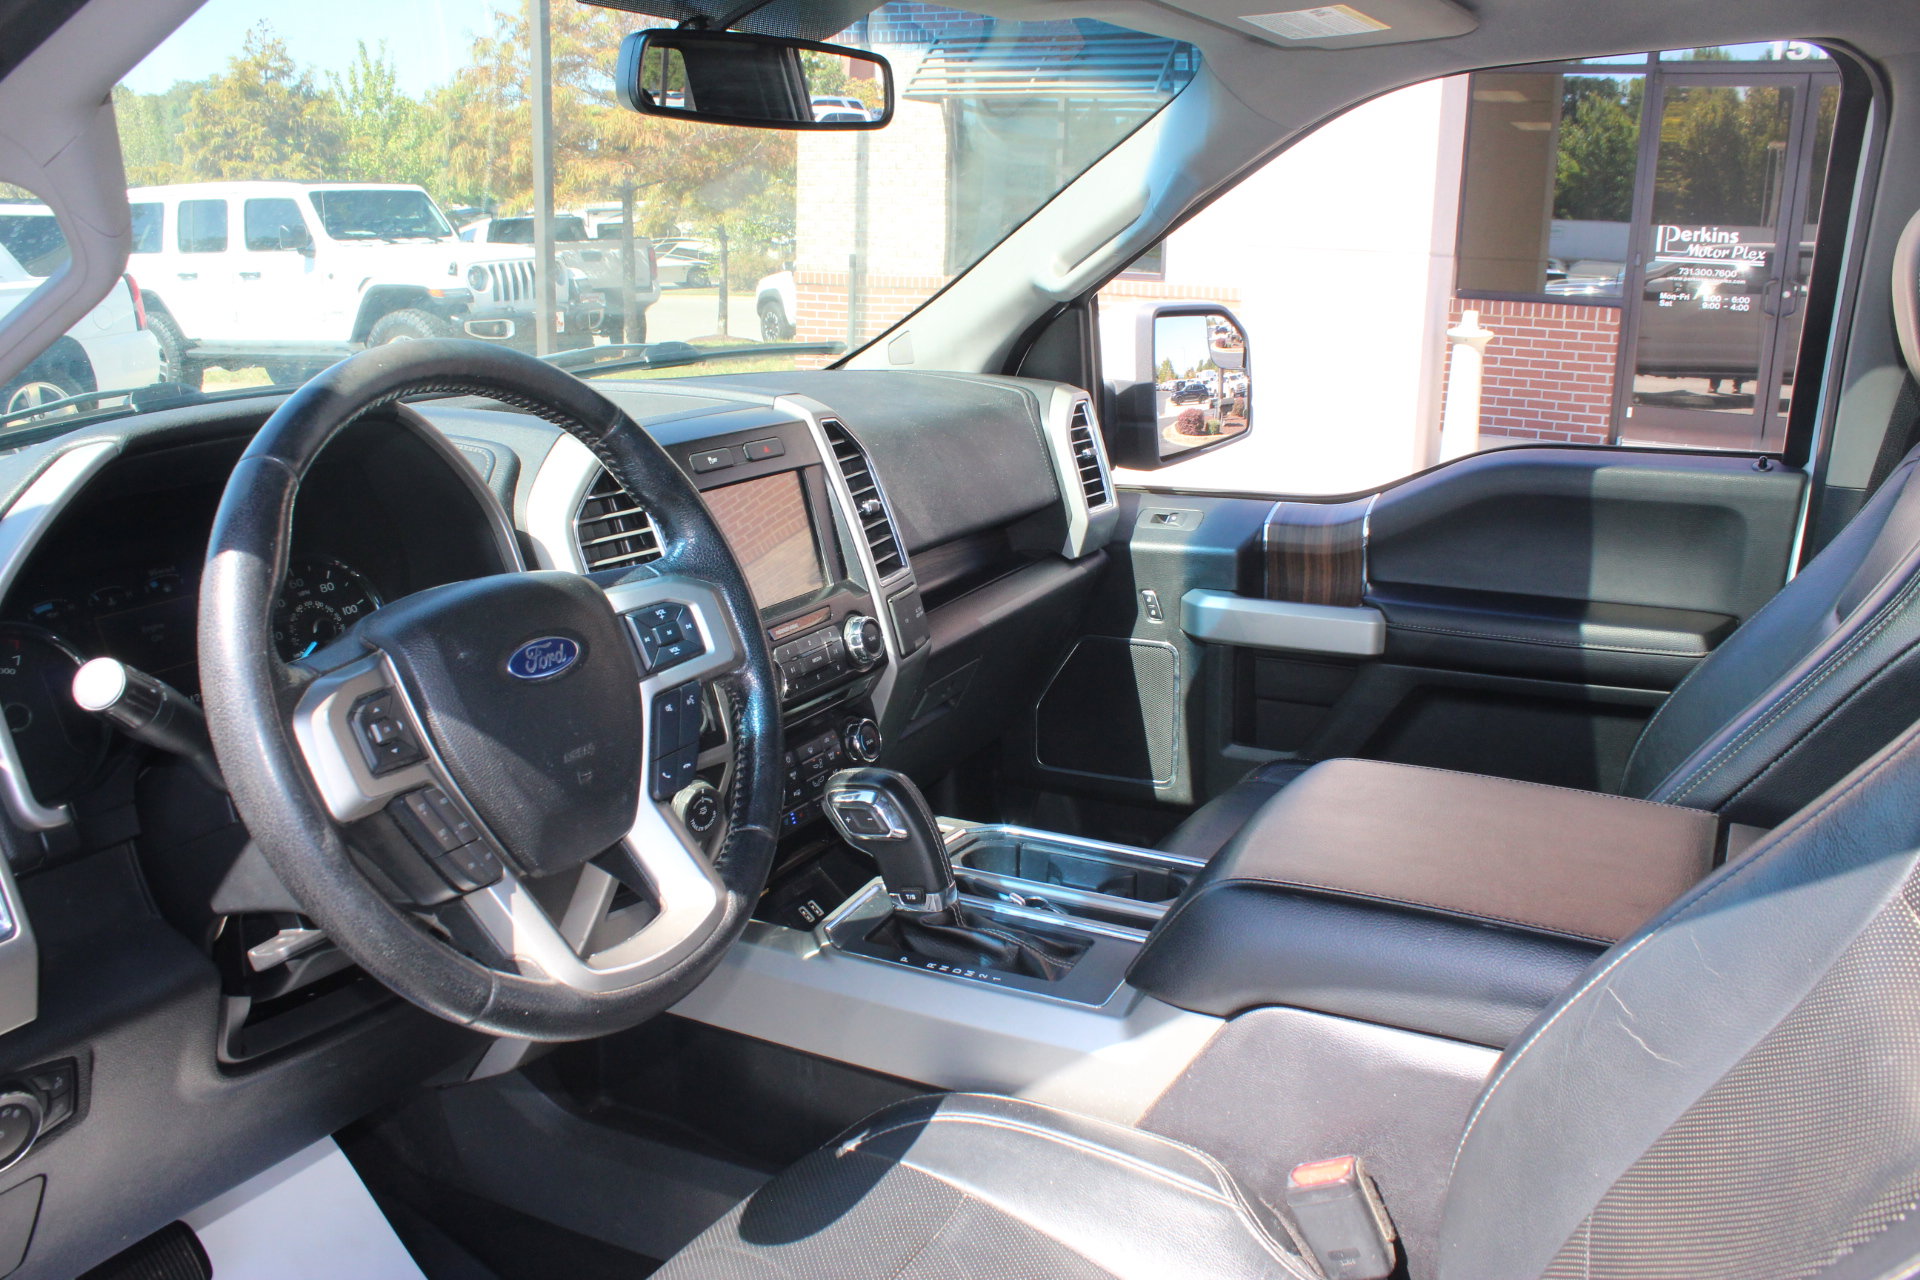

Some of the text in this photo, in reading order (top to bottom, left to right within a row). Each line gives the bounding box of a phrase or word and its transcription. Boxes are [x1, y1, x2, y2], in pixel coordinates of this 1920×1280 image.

[1768, 40, 1828, 61] 15
[1655, 225, 1740, 250] Perkins
[1687, 243, 1767, 261] Motor Plex
[1659, 292, 1691, 302] Mon-Fri
[1658, 300, 1673, 308] Sat
[288, 577, 305, 590] 60
[319, 581, 335, 593] 80
[341, 604, 358, 616] 100
[12, 654, 21, 667] 7
[525, 641, 567, 674] Ford
